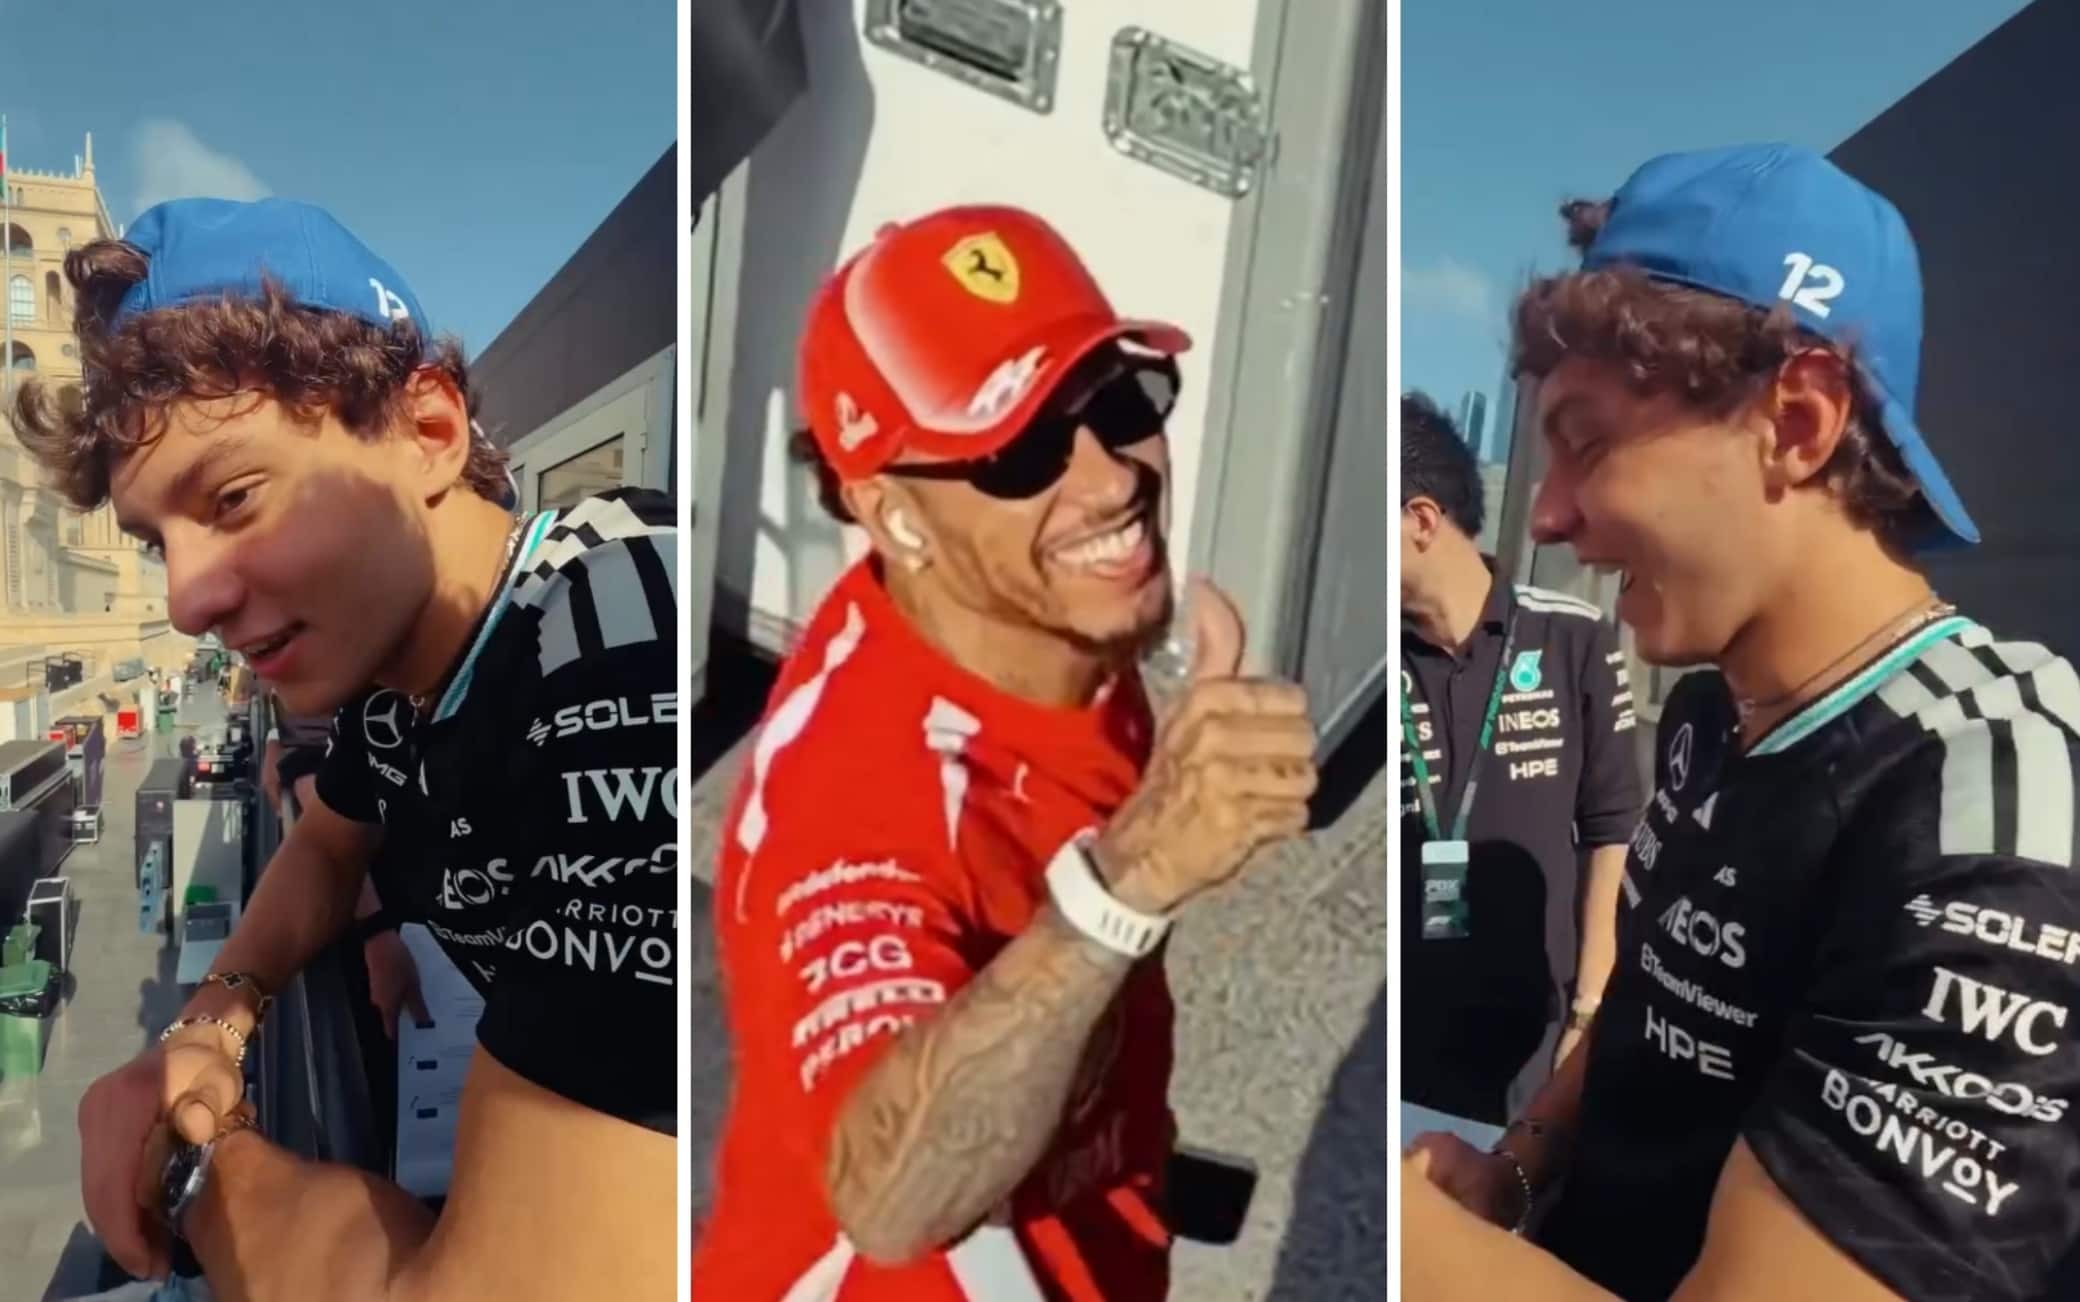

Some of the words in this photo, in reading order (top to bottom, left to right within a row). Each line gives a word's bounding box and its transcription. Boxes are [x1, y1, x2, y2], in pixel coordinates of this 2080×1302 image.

[1778, 252, 1844, 319] 12
[1498, 708, 1560, 733] INEOS
[1510, 758, 1558, 780] HPE
[1645, 1005, 1735, 1081] HPE
[1921, 965, 2067, 1055] IWC
[1820, 1069, 2020, 1216] BONVOY
[1862, 1077, 2006, 1161] ARRIOTT
